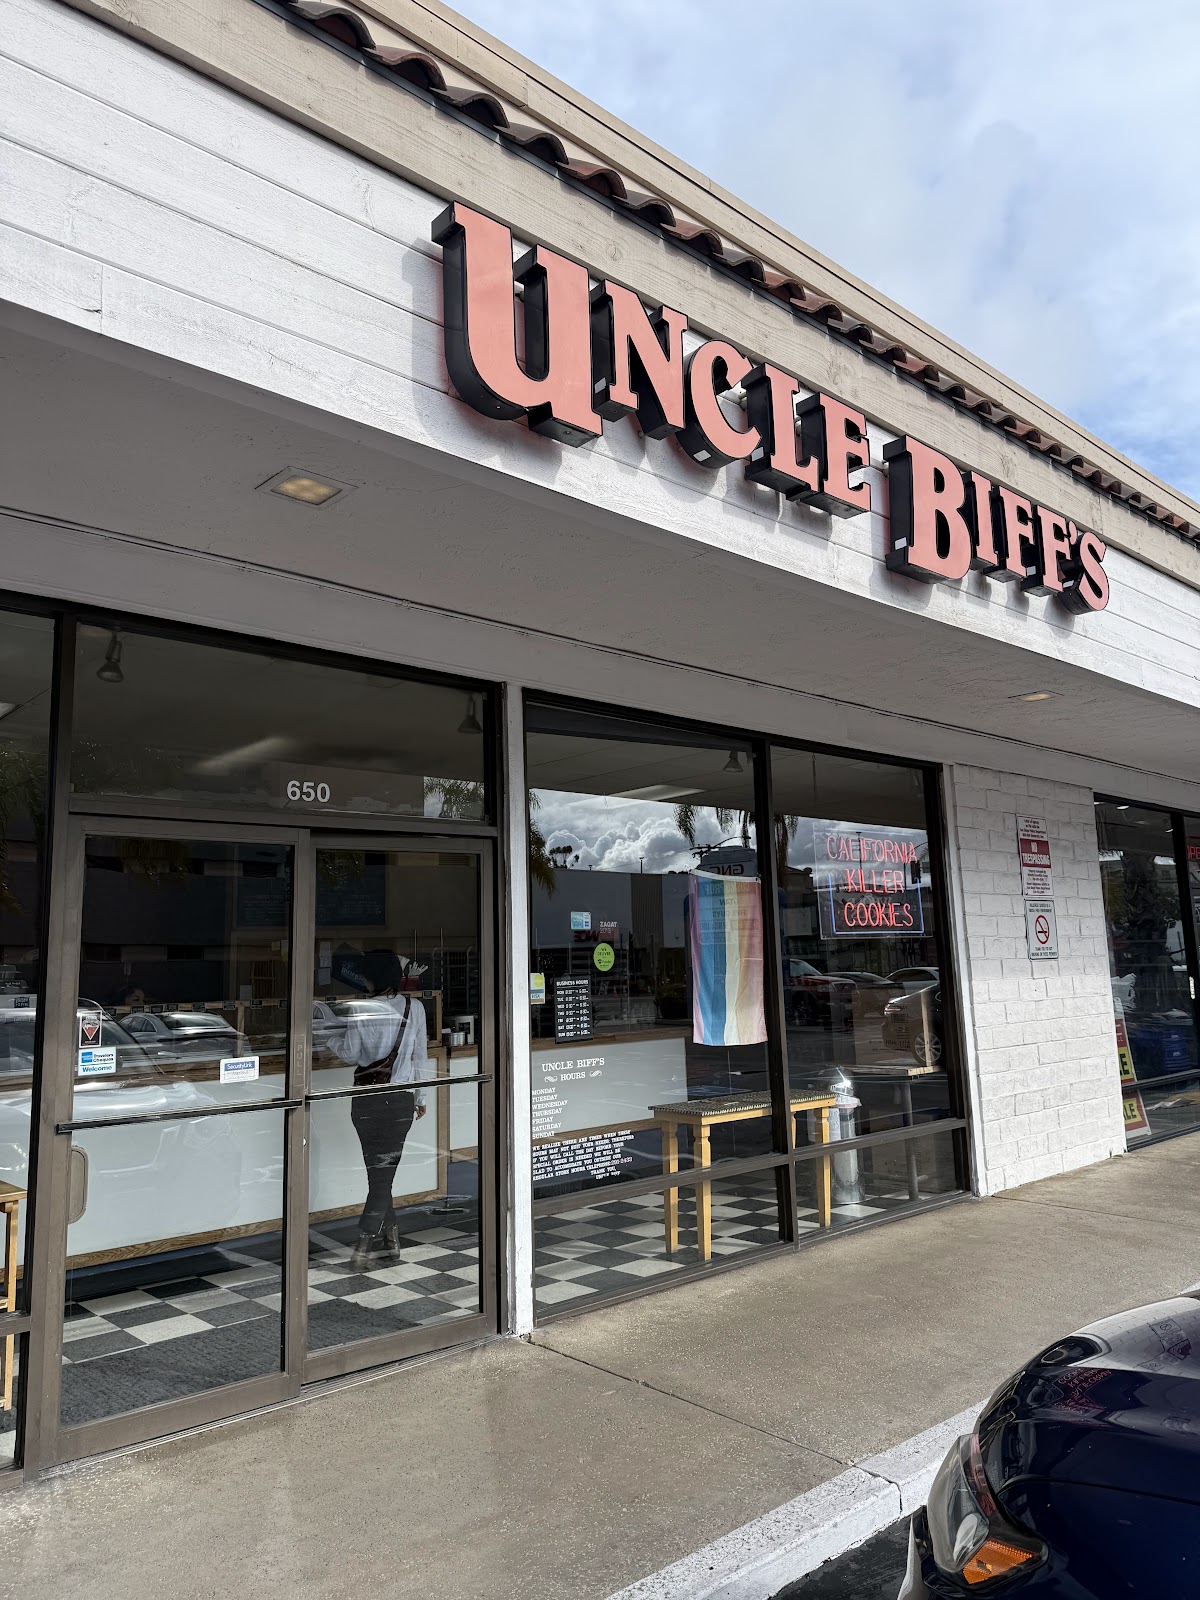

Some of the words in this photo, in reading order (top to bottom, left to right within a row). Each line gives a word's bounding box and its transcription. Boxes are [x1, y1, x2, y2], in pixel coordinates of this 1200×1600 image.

[438, 202, 871, 513] UNCLE
[889, 435, 1110, 612] BIFF'S
[286, 779, 331, 804] 650
[826, 835, 918, 864] CALIFORNIA
[1022, 853, 1050, 866] TRESPASSING
[845, 868, 905, 894] KILLER
[844, 902, 914, 927] COOKIES
[82, 1065, 112, 1073] Welcome
[542, 1060, 573, 1072] UNCLE
[577, 1057, 605, 1068] BIFF'S
[560, 1071, 586, 1081] HOURS
[532, 1087, 556, 1096] MONDAY
[532, 1094, 558, 1103] TUESDAY
[532, 1100, 568, 1110] WEDNESDAY
[532, 1108, 562, 1118] THURSDAY
[532, 1116, 554, 1125] FRIDAY
[532, 1122, 561, 1132] SATURDAY
[532, 1131, 555, 1139] SUNDAY
